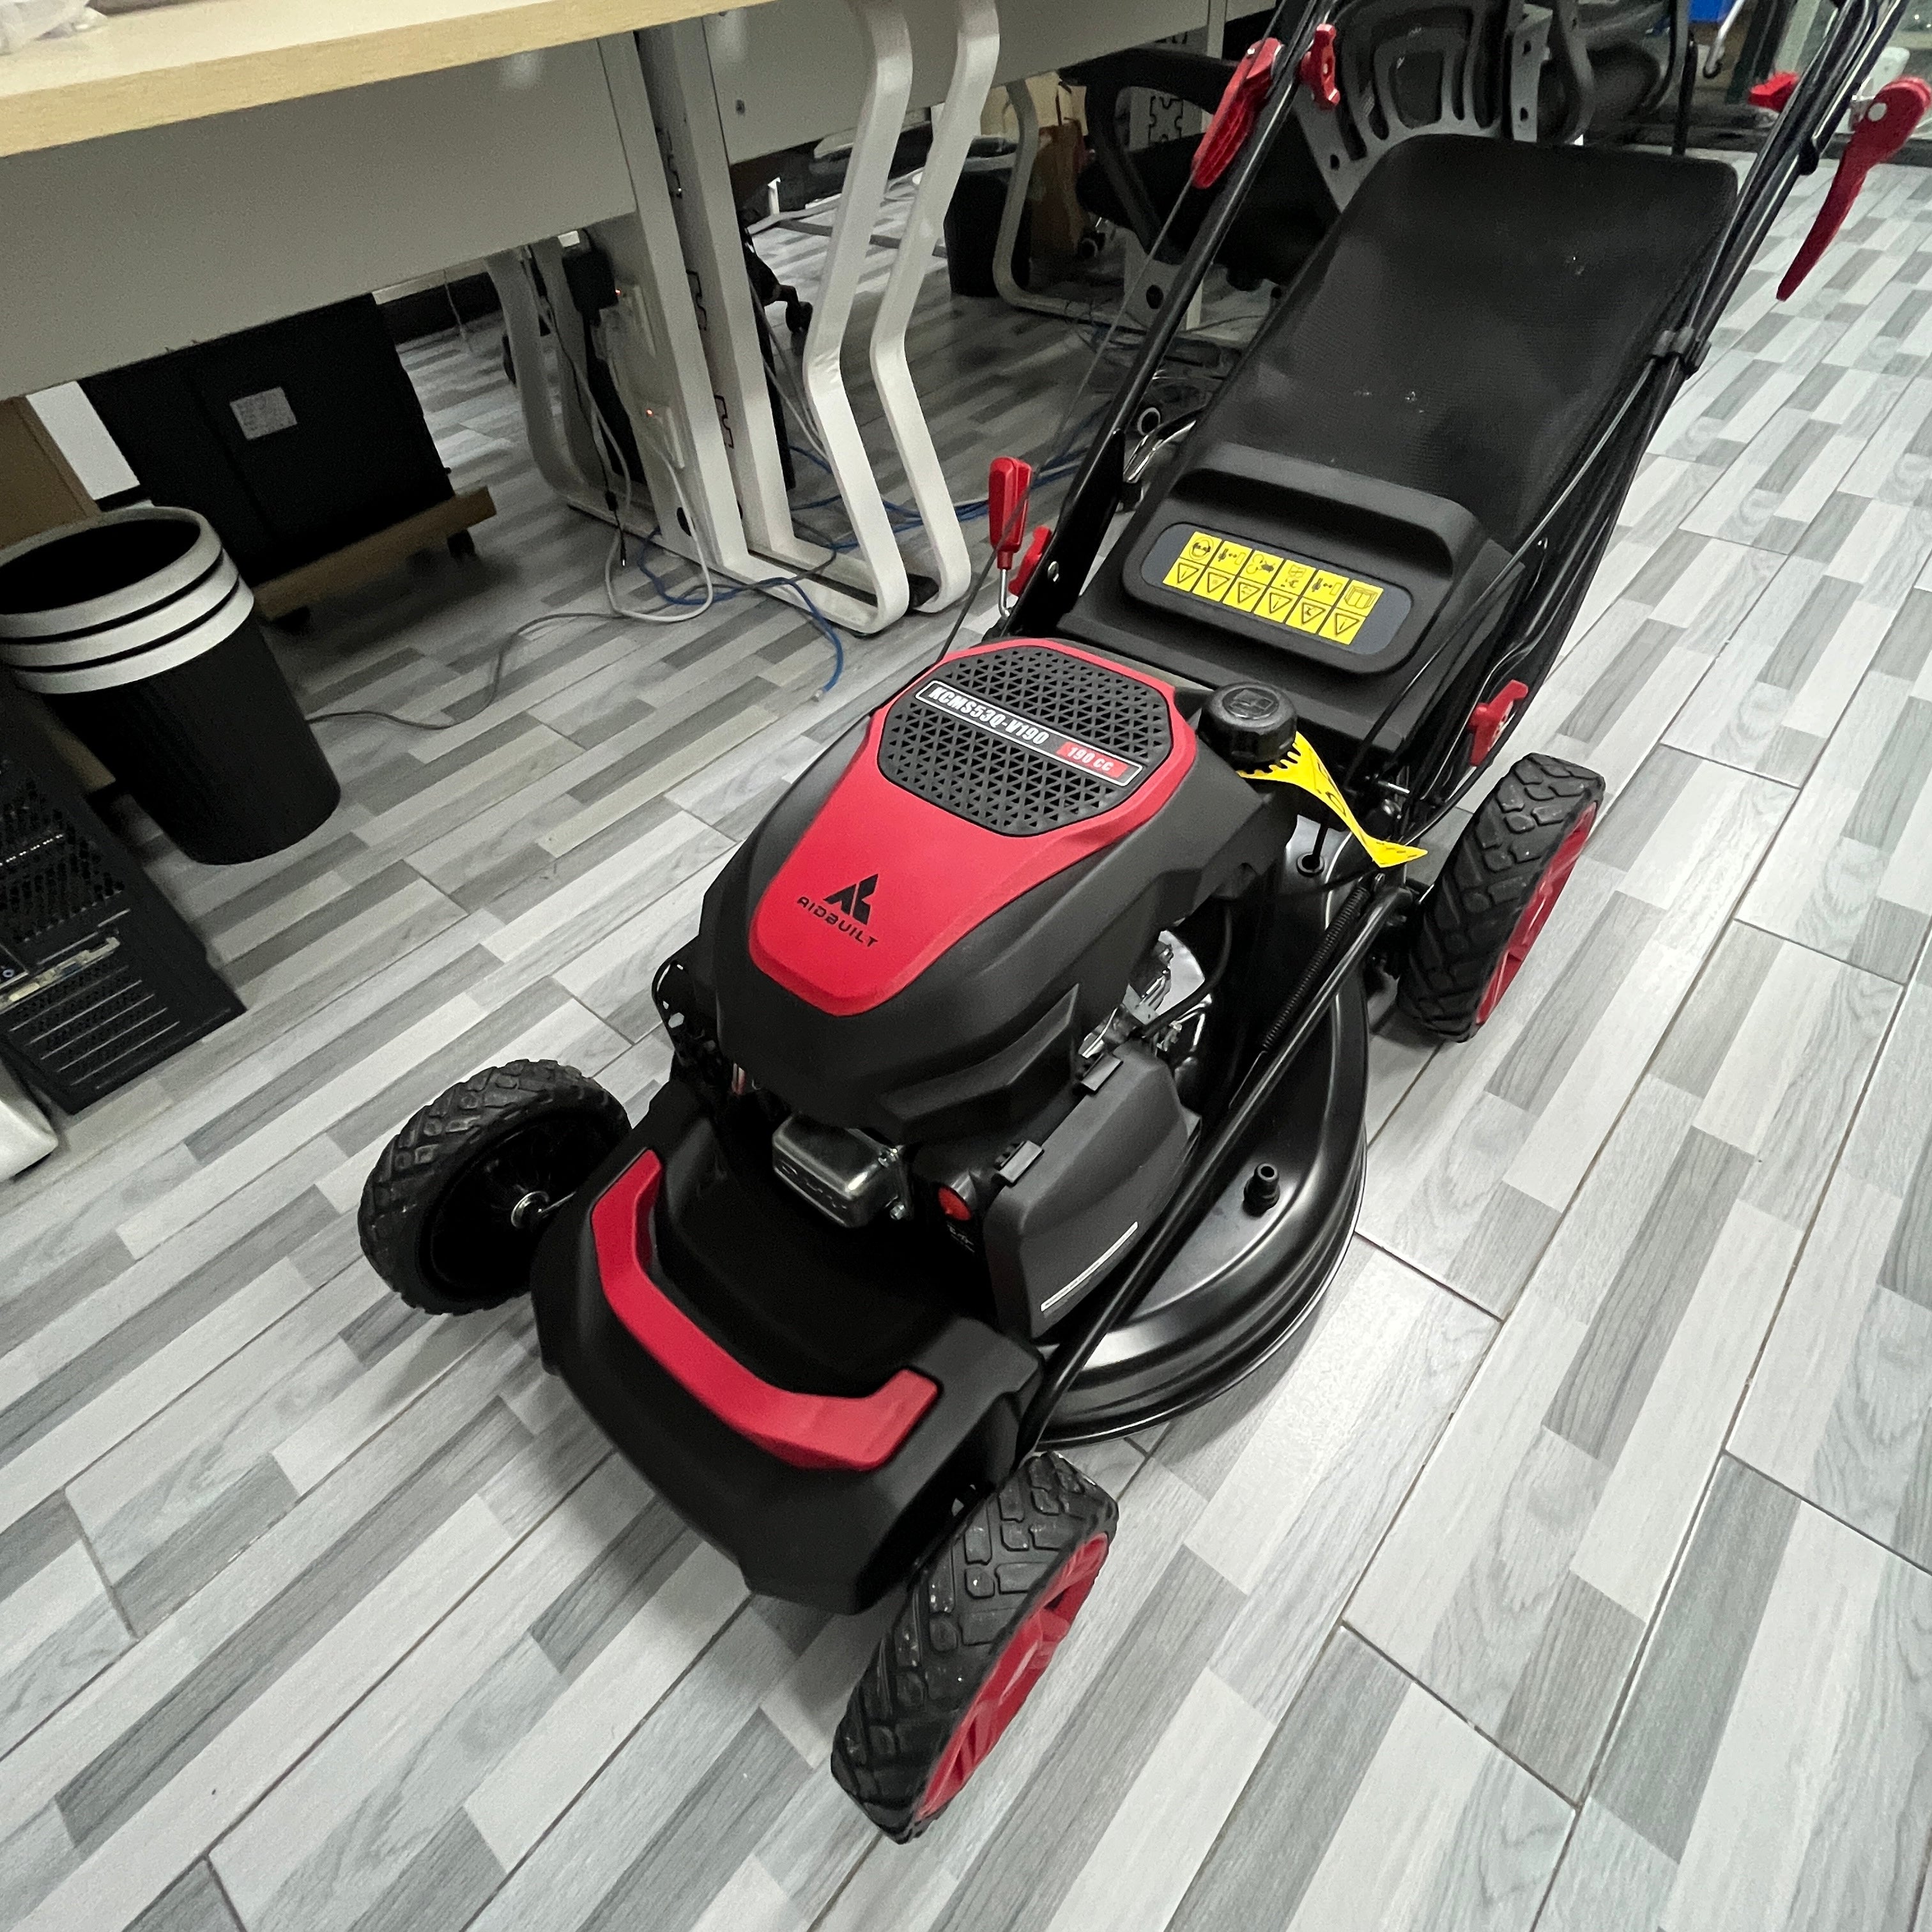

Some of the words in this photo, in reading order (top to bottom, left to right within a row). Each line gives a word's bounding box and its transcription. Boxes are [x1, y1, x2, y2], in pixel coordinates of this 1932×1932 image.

[928, 687, 1050, 744] KCMS53Q-V190
[1067, 746, 1096, 763] 190
[797, 896, 878, 947] AIDBUILT
